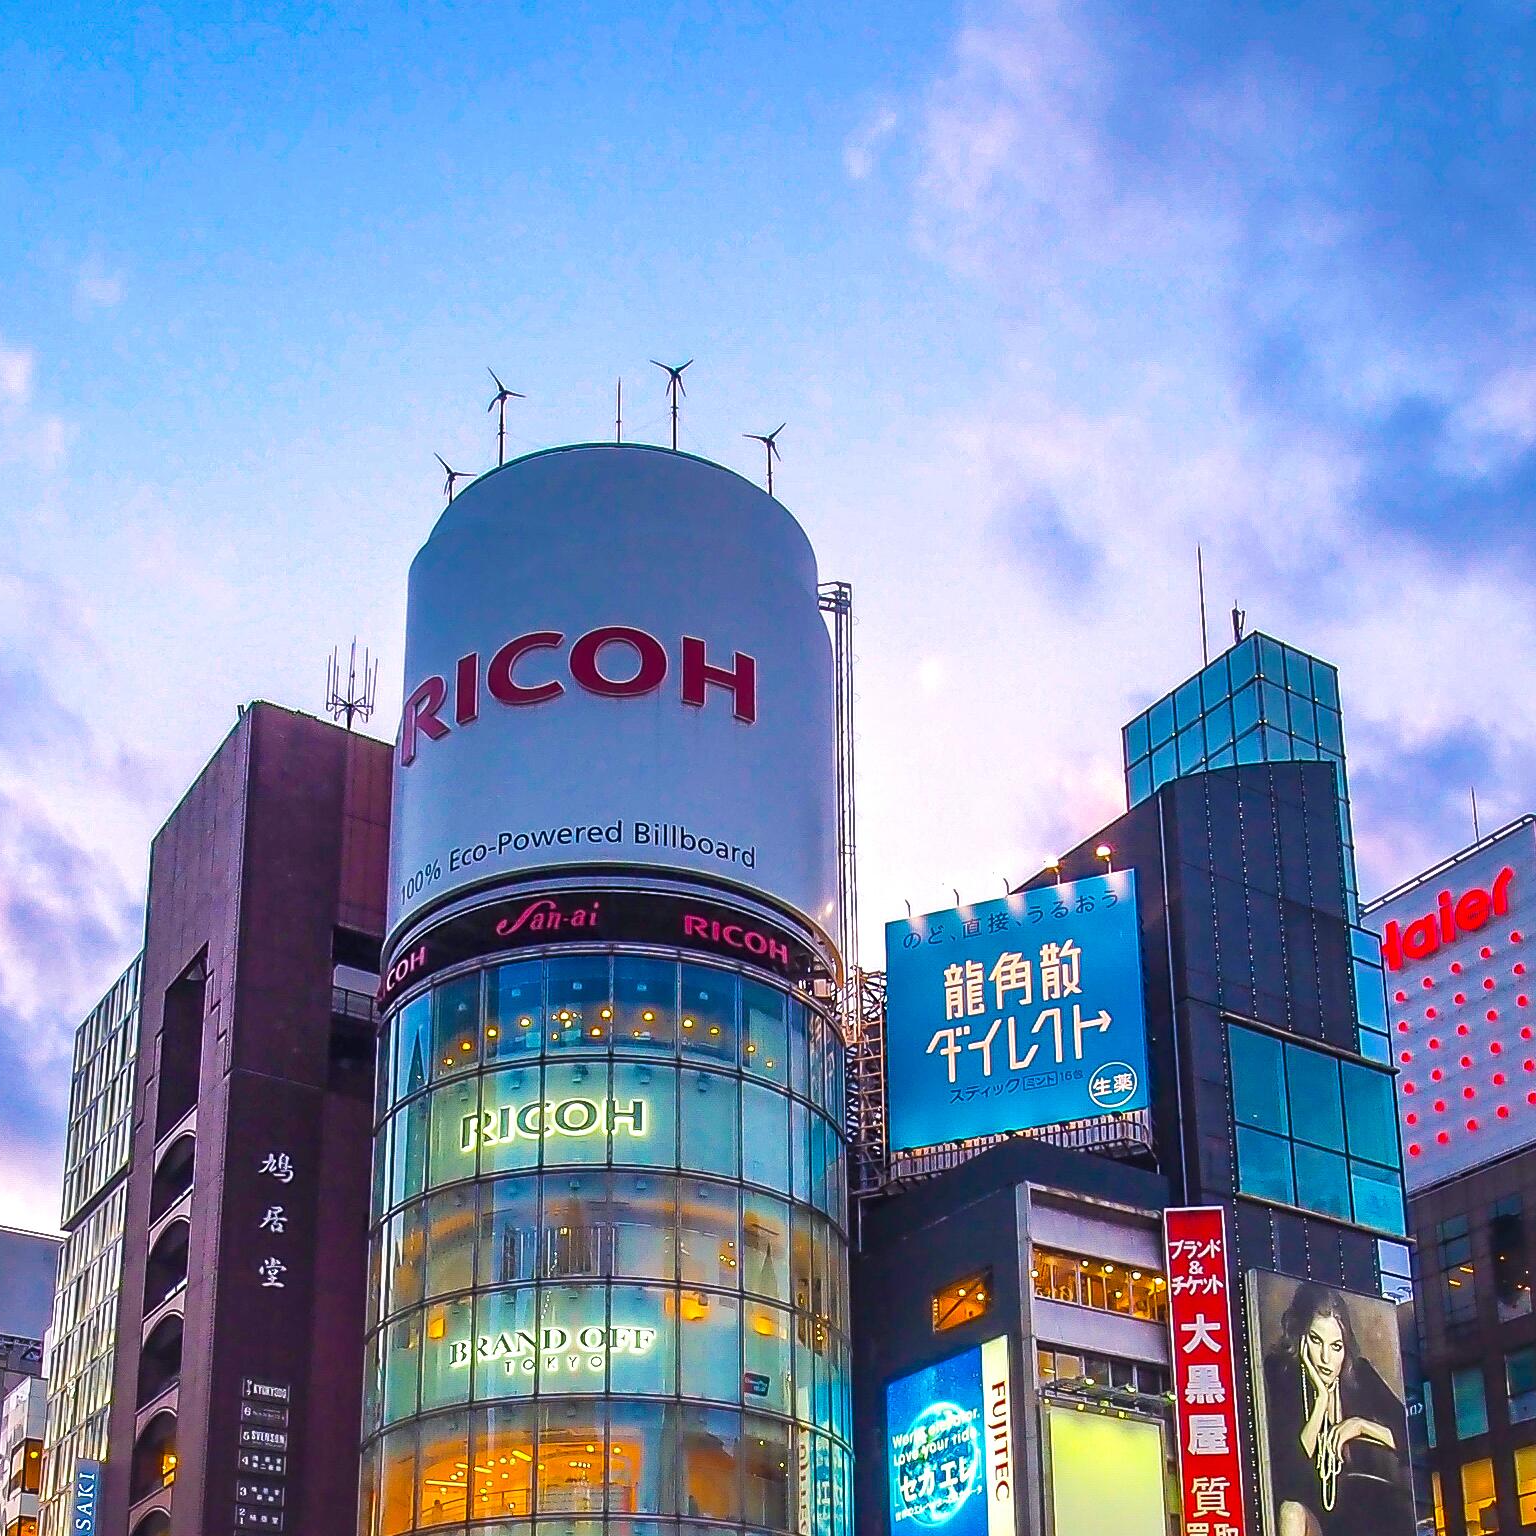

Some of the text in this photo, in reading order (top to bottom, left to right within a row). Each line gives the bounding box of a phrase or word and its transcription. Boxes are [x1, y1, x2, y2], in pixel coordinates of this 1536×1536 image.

[400, 625, 757, 768] RICOH
[400, 820, 757, 905] 100% Eco-Powered Billboard
[495, 900, 600, 937] San-ai
[683, 913, 790, 965] RICOH
[902, 889, 1119, 950] のど、直接、うるおう
[943, 938, 1083, 1021] 龍角散
[925, 1003, 1112, 1084] ダイレクト
[949, 1079, 1021, 1104] スティック
[1091, 1071, 1135, 1096] 生薬
[461, 1099, 649, 1152] RICOH
[257, 1151, 295, 1290] 鳩居堂
[1168, 1238, 1222, 1261] ブランド
[1188, 1260, 1205, 1275] &
[1171, 1273, 1224, 1297] チケット
[448, 1325, 656, 1367] BRAND OFF
[504, 1355, 605, 1375] TOKYO
[1181, 1313, 1230, 1457] 大黒屋
[922, 1436, 950, 1460] your
[987, 1380, 1010, 1502] FUJITEC
[1190, 1475, 1232, 1520] 質
